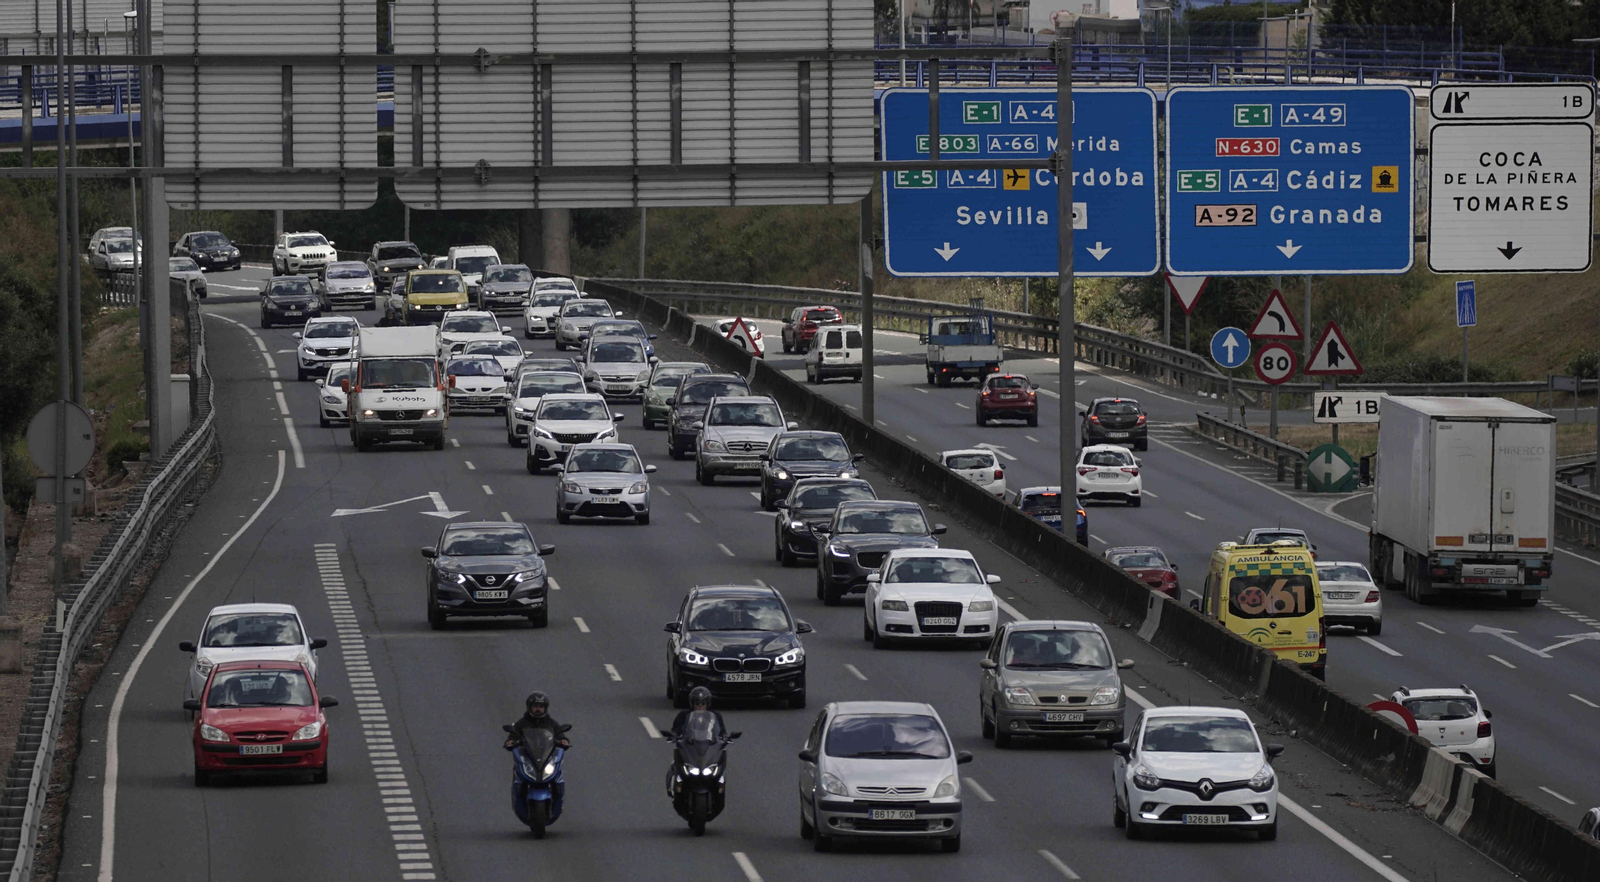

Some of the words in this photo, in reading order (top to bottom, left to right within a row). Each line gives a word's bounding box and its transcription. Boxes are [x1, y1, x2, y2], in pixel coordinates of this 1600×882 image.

[967, 105, 997, 120] E-1
[1014, 105, 1055, 120] A-4
[1238, 108, 1268, 123] E-1
[1285, 107, 1342, 123] A-49
[919, 138, 976, 150] E803
[990, 138, 1034, 150] A-66
[1046, 136, 1119, 152] Mrida
[1218, 141, 1277, 154] N-630
[1290, 139, 1362, 154] Camas
[1479, 152, 1543, 167] COCA
[898, 170, 934, 184] E-5
[950, 170, 991, 184] A-4
[1035, 168, 1144, 187] Crdoba
[1180, 174, 1217, 188] E-5
[1233, 173, 1275, 188] A-4
[1286, 169, 1362, 189] Cádiz
[1445, 173, 1466, 185] DE
[1476, 173, 1497, 185] LA
[1507, 170, 1577, 185] PIÑERA
[1453, 196, 1569, 212] TOMARES
[956, 206, 1049, 225] Sevilla
[1199, 208, 1254, 223] A-92
[1270, 205, 1382, 224] Granada
[1263, 356, 1289, 371] 80
[1237, 555, 1304, 563] AMBULANCIA
[1068, 713, 1082, 721] CHV
[245, 745, 264, 753] 9501
[874, 810, 896, 818] 8617
[899, 810, 915, 819] GGX
[1187, 815, 1208, 823] 3269
[1211, 815, 1227, 824] LBV
